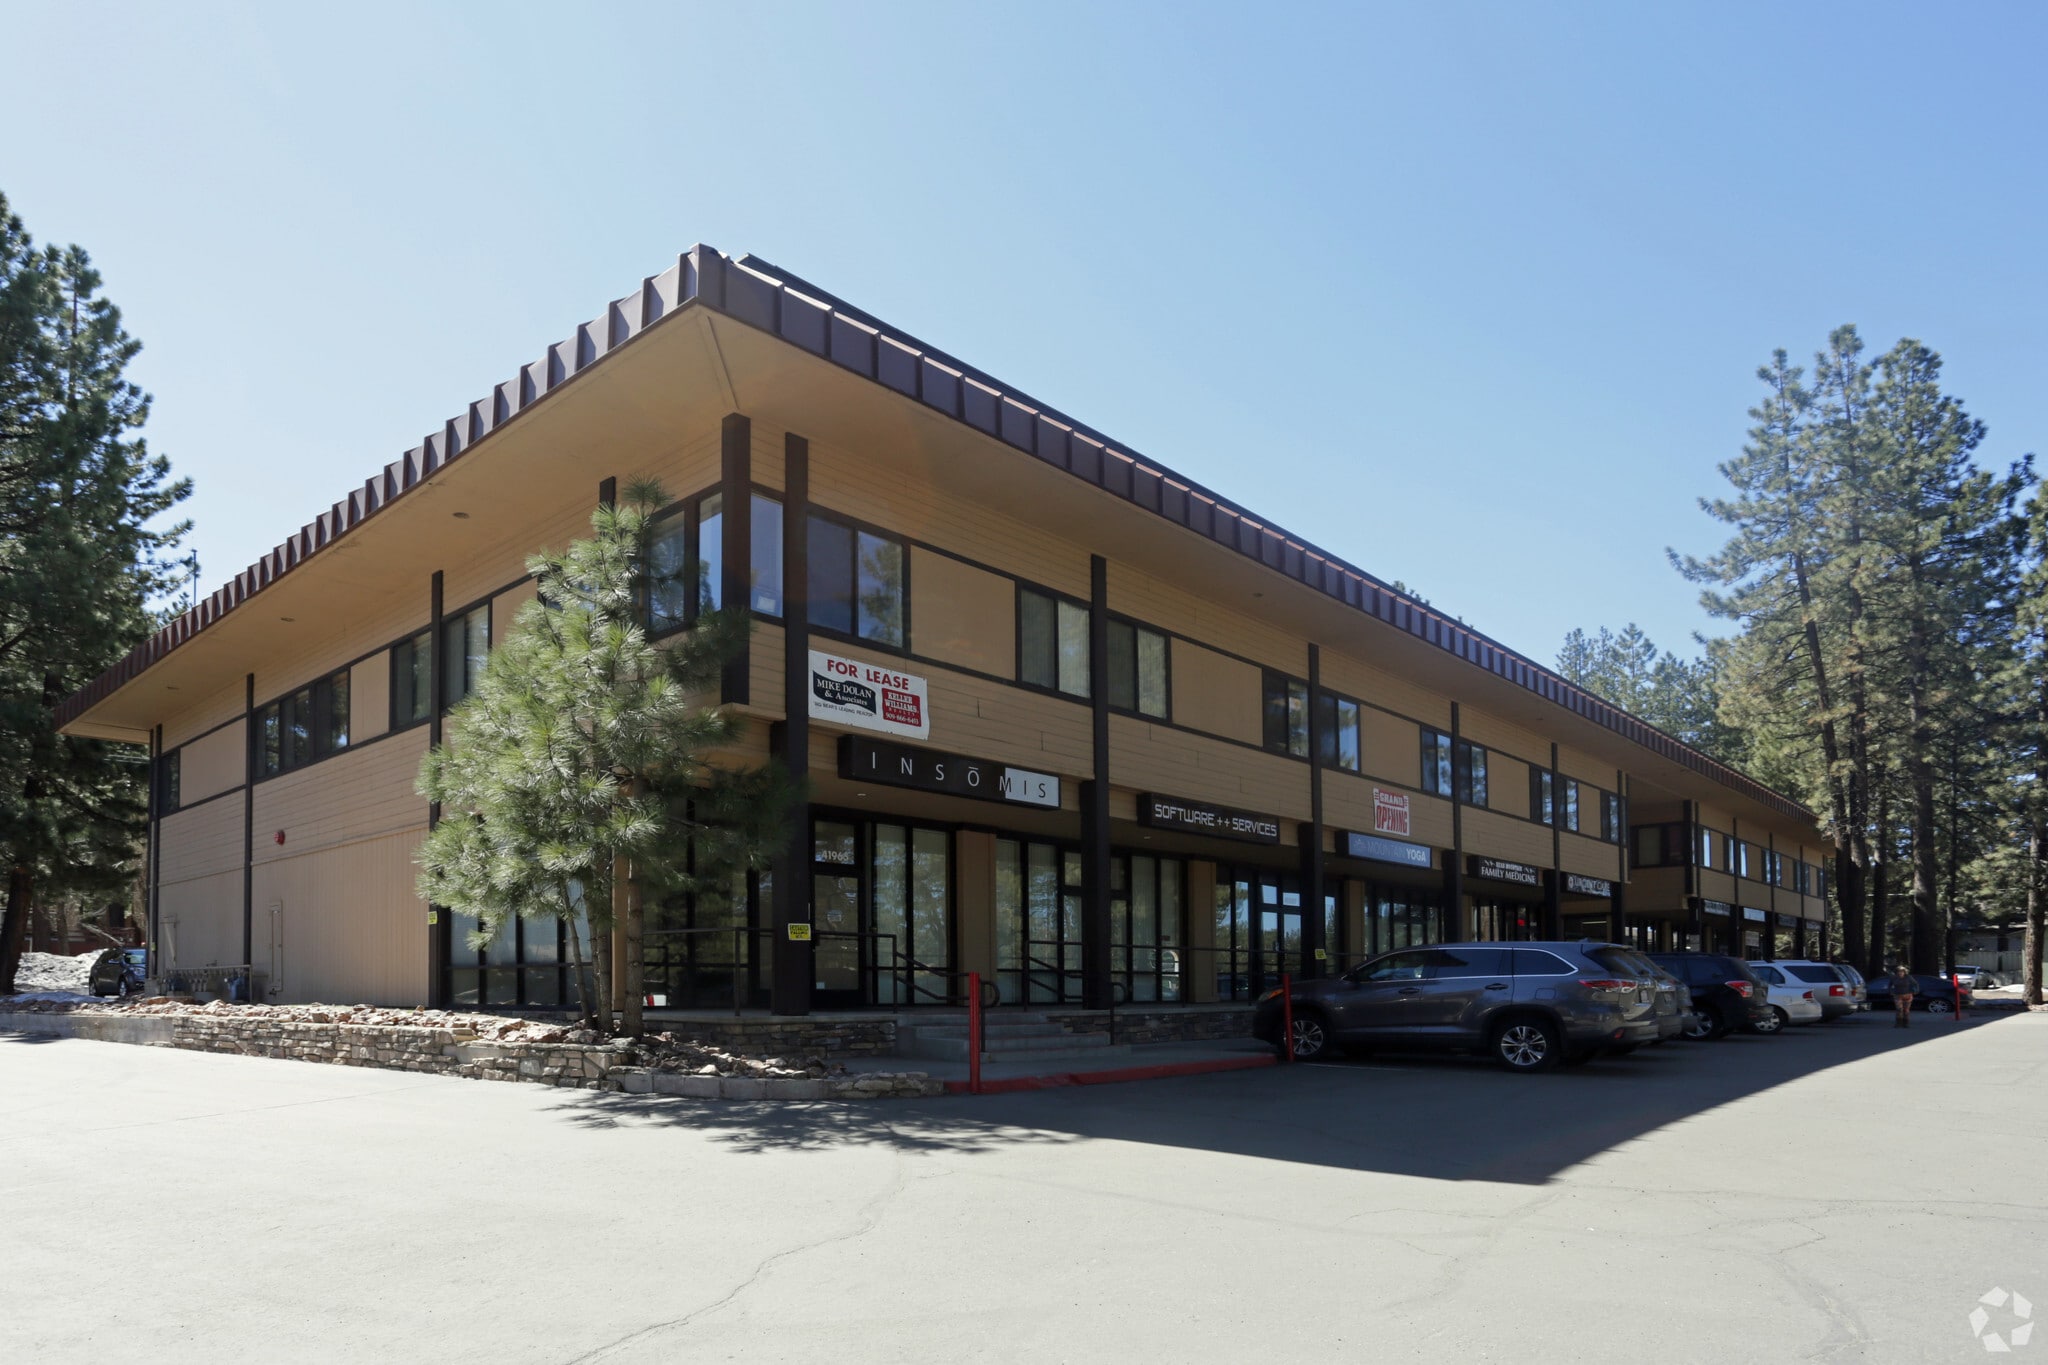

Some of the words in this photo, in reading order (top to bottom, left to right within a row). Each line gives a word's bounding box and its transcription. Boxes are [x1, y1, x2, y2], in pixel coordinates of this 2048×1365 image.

[827, 659, 858, 679] FOR
[866, 669, 909, 690] LEASE
[817, 678, 841, 690] MIKE
[842, 684, 873, 699] DOLAN
[887, 691, 913, 704] KELLER
[835, 692, 868, 706] Associates
[1379, 792, 1404, 806] GRAND
[1154, 804, 1215, 826] SOFTWARE
[1232, 818, 1277, 837] SERVICES
[1376, 805, 1408, 834] OPENING
[1406, 848, 1426, 862] YOGA
[1481, 866, 1505, 878] FAMILY
[1505, 870, 1537, 884] MEDICINE
